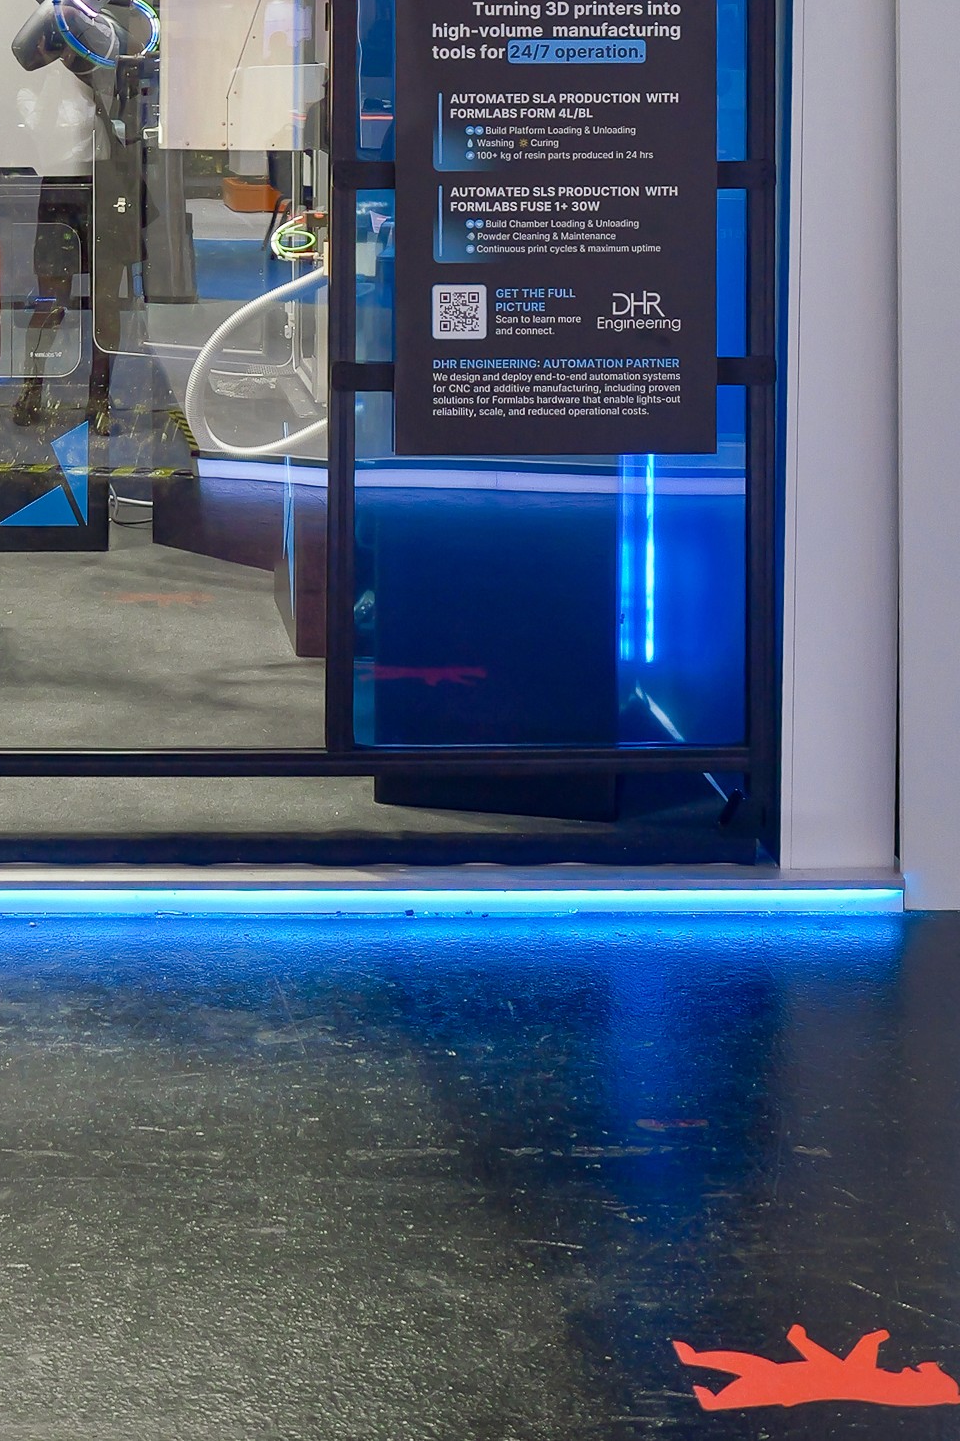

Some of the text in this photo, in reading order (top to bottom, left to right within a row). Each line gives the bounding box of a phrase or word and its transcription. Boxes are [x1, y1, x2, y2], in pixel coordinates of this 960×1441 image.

[472, 0, 682, 20] Turning 3D printers into
[432, 21, 681, 41] high-volume manufacturing
[431, 43, 644, 62] tools for 24/7 operation.
[449, 92, 679, 104] AUTOMATED SLA PRODUCTION WITH
[450, 107, 594, 120] FORMLABS FORM 4L/BL
[485, 125, 637, 137] Build Platform Loading & Unloading
[476, 138, 559, 149] Washing Curing
[476, 150, 654, 162] 100+ kg of resin parts produced in 24 hrs
[450, 185, 679, 198] AUTOMATED SLS PRODUCTION WITH
[450, 200, 601, 212] FORMLABS FUSE 1+ 30W
[485, 218, 640, 230] Build Chamber Loading & Unloading
[477, 231, 617, 242] Powder Cleaning & Maintenance
[476, 243, 662, 255] Continuous print cycles & maximum uptime
[495, 288, 577, 299] GET THE FULL
[495, 301, 546, 312] PICTURE
[612, 291, 666, 317] DHR
[495, 314, 582, 324] Scan to learn more
[596, 316, 682, 333] Engineering
[495, 326, 555, 336] and connect.
[432, 358, 680, 369] DHR ENGINEERING: AUTOMATION PARTNER
[432, 371, 681, 384] We design and deploy end-to-end automation systems
[432, 383, 681, 395] for CNC and additive manufacturing, including proven
[432, 394, 681, 406] solutions for Formlabs hardware that enable lights-out
[432, 406, 650, 418] reliability, scale, and reduced operational costs.
